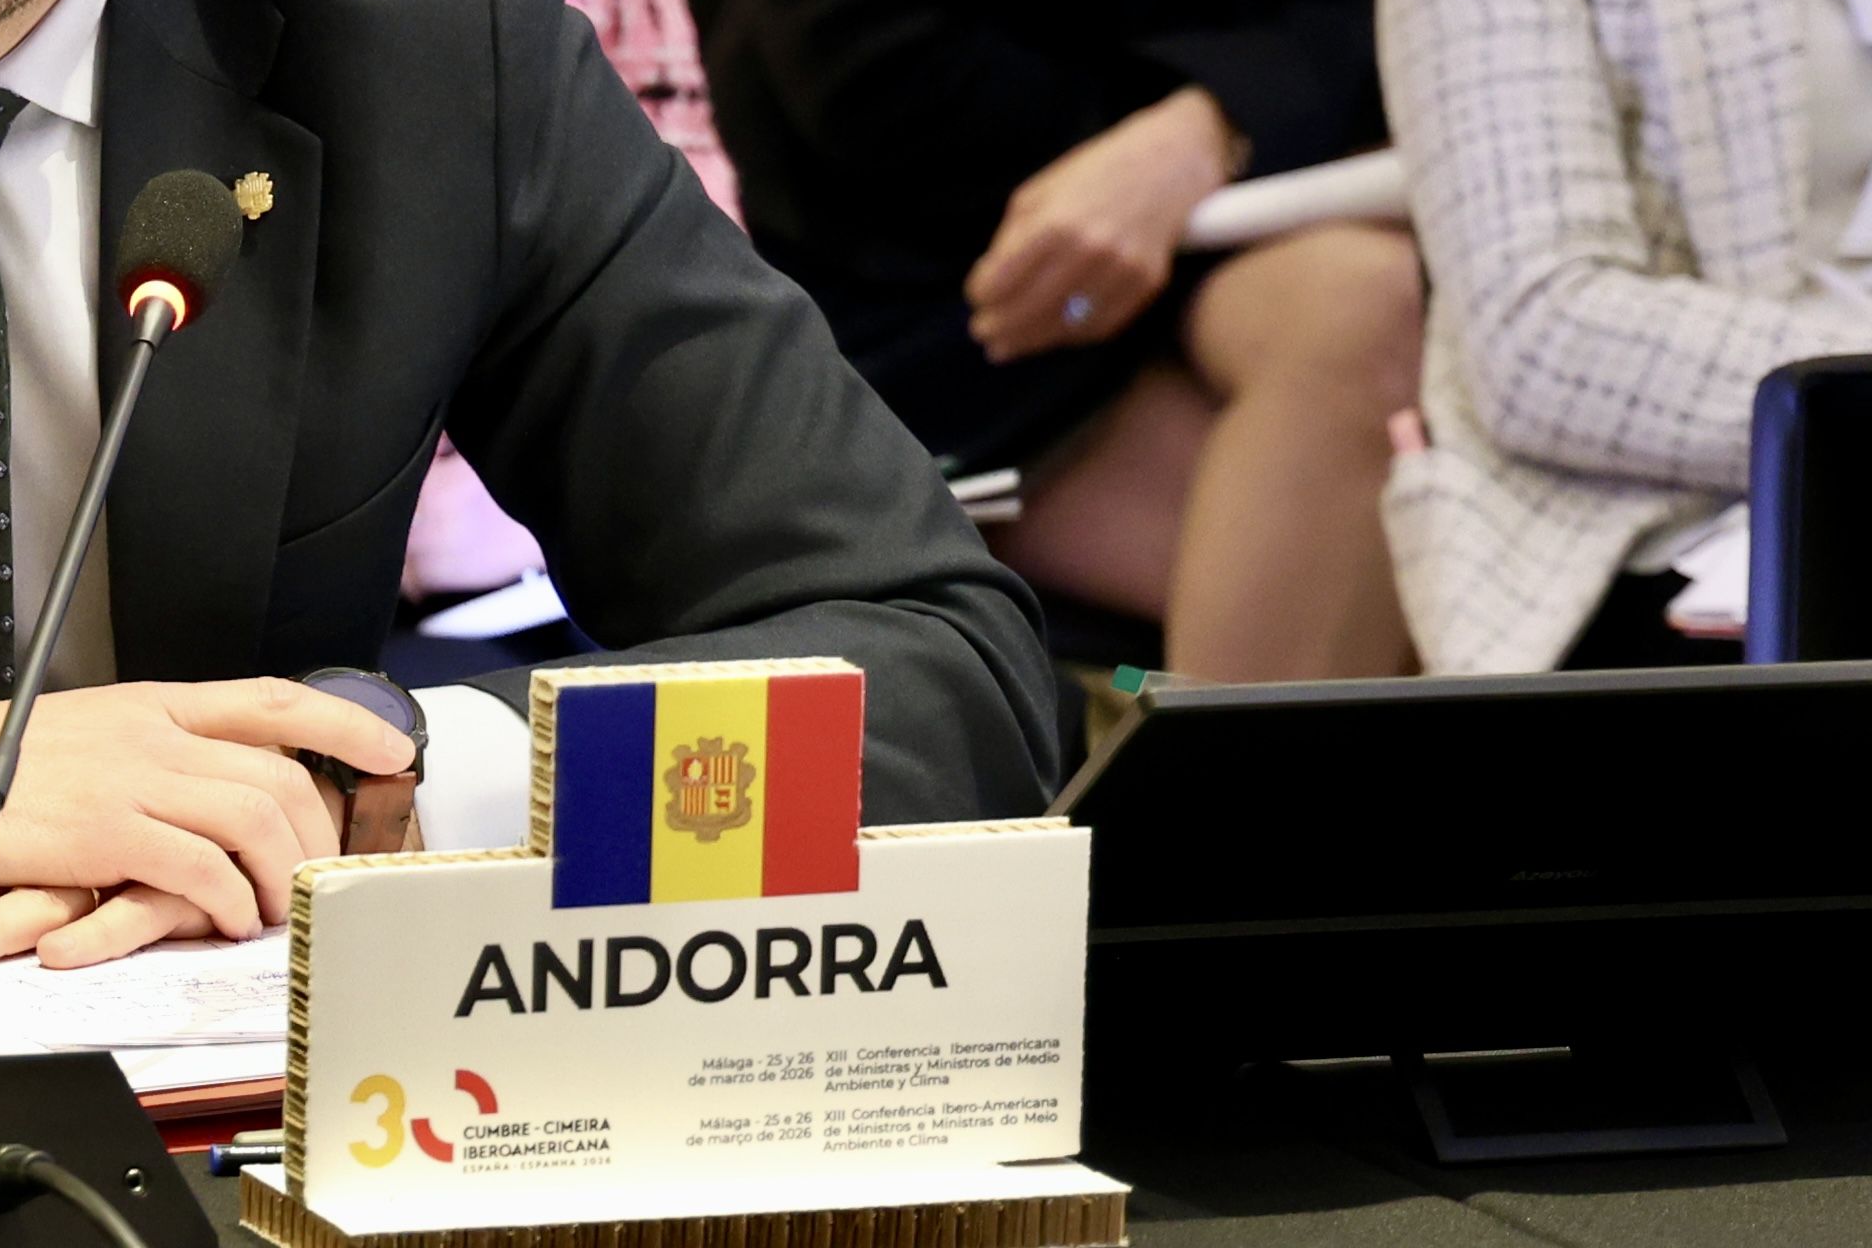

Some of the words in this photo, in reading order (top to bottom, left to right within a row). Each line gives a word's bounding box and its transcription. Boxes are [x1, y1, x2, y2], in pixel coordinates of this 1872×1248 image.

[453, 919, 948, 1018] ANDORRA
[857, 1045, 940, 1061] Conferencia
[951, 1038, 1061, 1054] Iberoamericana
[702, 1056, 754, 1071] Málaga
[766, 1054, 782, 1067] 25
[786, 1056, 794, 1069] y
[798, 1052, 815, 1065] 26
[825, 1065, 842, 1078] de
[848, 1061, 911, 1076] Ministras
[928, 1057, 991, 1071] Ministros
[995, 1055, 1012, 1067] de
[1017, 1052, 1061, 1066] Medio
[688, 1074, 706, 1087] de
[710, 1073, 755, 1086] marzo
[758, 1070, 776, 1082] de
[780, 1067, 815, 1081] 2026
[825, 1077, 894, 1093] Ambiente
[910, 1074, 950, 1088] Clima
[852, 1104, 935, 1121] Conferência
[942, 1097, 1058, 1115] Ibero-Americana
[463, 1122, 530, 1140] CUMBRE
[543, 1117, 611, 1135] CIMEIRA
[700, 1117, 751, 1131] Málaga
[764, 1114, 780, 1127] 25
[796, 1112, 812, 1125] 26
[824, 1125, 841, 1137] de
[848, 1121, 911, 1136] Ministros
[932, 1116, 994, 1131] Ministras
[1001, 1114, 1018, 1126] do
[1025, 1111, 1058, 1125] Meio
[686, 1135, 703, 1147] de
[708, 1133, 753, 1146] março
[757, 1130, 774, 1142] de
[778, 1127, 812, 1141] 2026
[823, 1137, 892, 1153] Ambiente
[909, 1134, 949, 1147] Clima
[463, 1138, 611, 1160] IBEROAMERICANA
